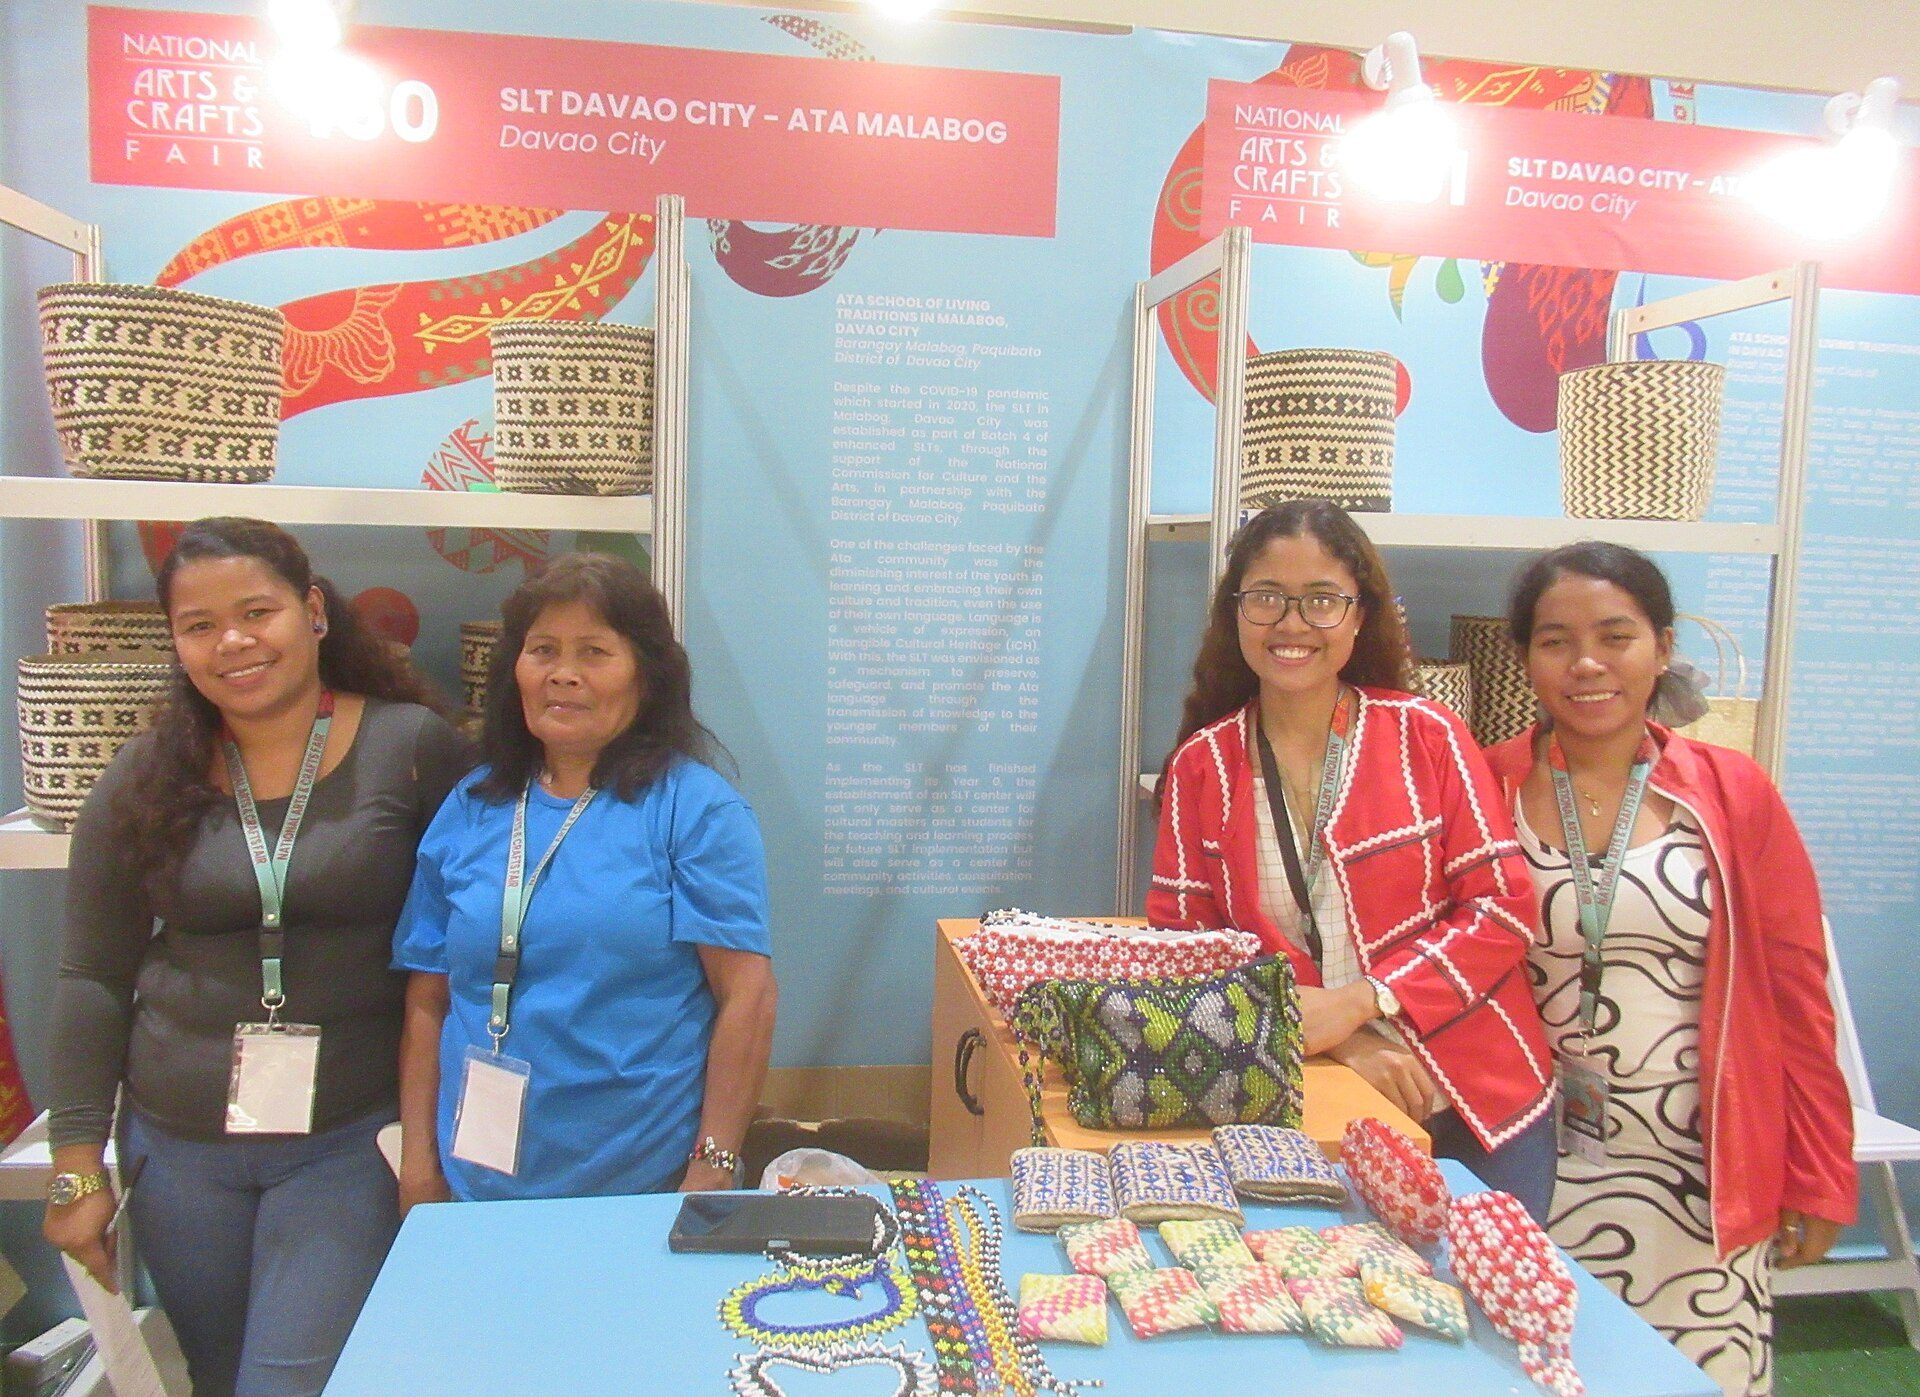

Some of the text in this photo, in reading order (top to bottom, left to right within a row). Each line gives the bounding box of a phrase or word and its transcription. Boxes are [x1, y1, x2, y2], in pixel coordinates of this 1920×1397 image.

[123, 33, 262, 65] NATIONAL
[133, 68, 259, 102] ARTS &
[126, 100, 264, 136] CRAFTS
[500, 87, 554, 115] SLT
[562, 90, 677, 122] DAVAO
[685, 100, 756, 128] CITY
[787, 107, 849, 135] ATA
[856, 112, 1008, 144] MALABOG
[1235, 104, 1345, 134] NATIONAL
[499, 124, 666, 165] Davao City
[1239, 136, 1307, 167] ARTS
[1233, 164, 1342, 199] CRAFTS
[1507, 157, 1547, 178] SLT
[1550, 160, 1634, 185] DAVAO
[1639, 170, 1690, 191] CITY
[1505, 186, 1638, 221] Davao City
[836, 308, 917, 323] TRADITIONS
[837, 294, 863, 306] ATA
[868, 295, 922, 308] SCHOOL
[947, 298, 990, 311] LIVING
[836, 323, 918, 337] DAVAO CITY
[835, 352, 882, 365] District
[907, 354, 950, 367] Davao
[954, 356, 980, 371] City
[836, 337, 901, 353] Barangay
[973, 343, 1041, 359] Paquibato
